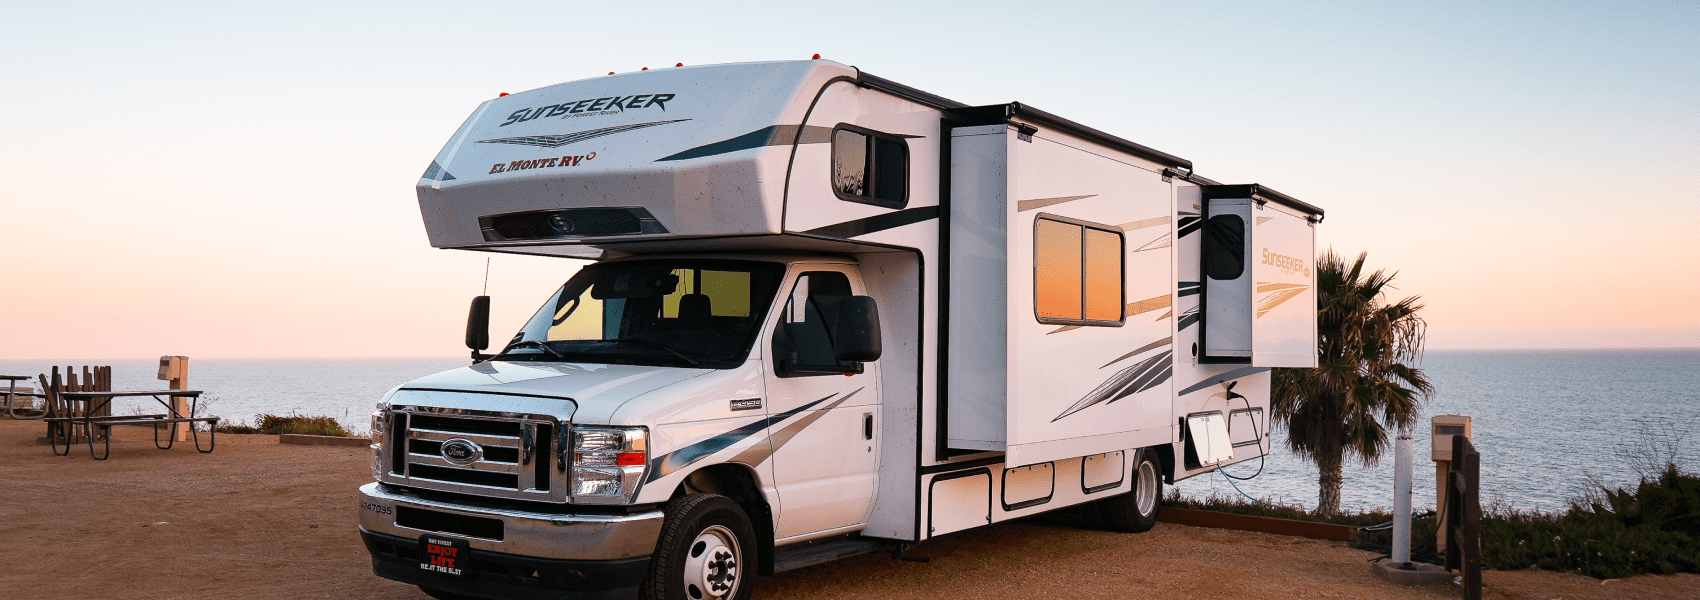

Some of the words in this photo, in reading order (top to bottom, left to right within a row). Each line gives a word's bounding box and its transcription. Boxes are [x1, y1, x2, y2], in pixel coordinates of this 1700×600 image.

[499, 93, 676, 127] SUNSEEKER
[488, 163, 506, 174] EL
[506, 157, 559, 172] MONTE
[558, 155, 584, 167] RV
[1262, 247, 1304, 272] SUNSEEKER
[427, 544, 458, 557] ENJOY
[431, 555, 455, 568] LIFE
[436, 565, 448, 573] THE
